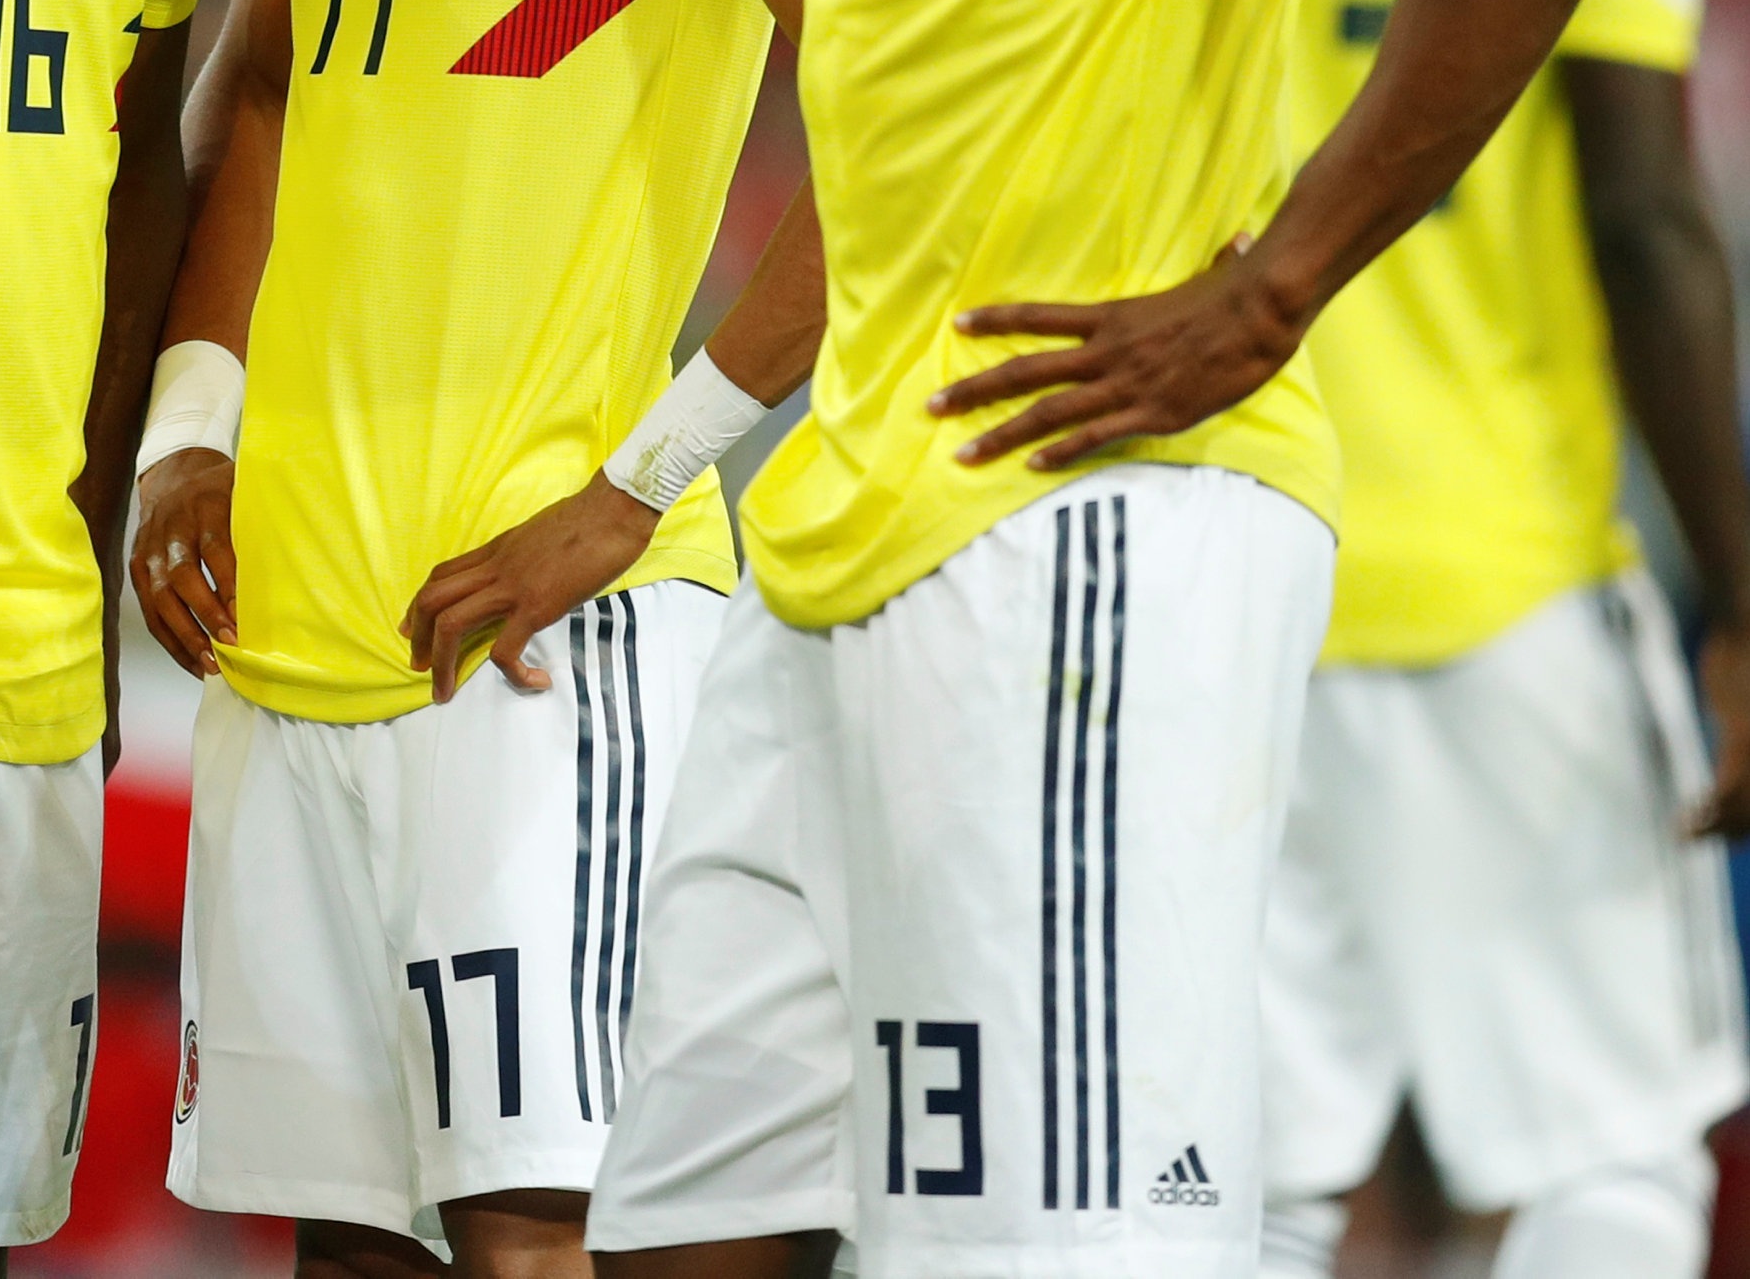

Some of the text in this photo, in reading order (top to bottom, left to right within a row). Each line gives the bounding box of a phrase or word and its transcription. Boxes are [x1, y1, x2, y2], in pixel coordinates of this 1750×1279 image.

[63, 993, 94, 1157] 1
[406, 947, 521, 1130] 17
[876, 1020, 983, 1196] 13
[1149, 1182, 1220, 1207] adidas
